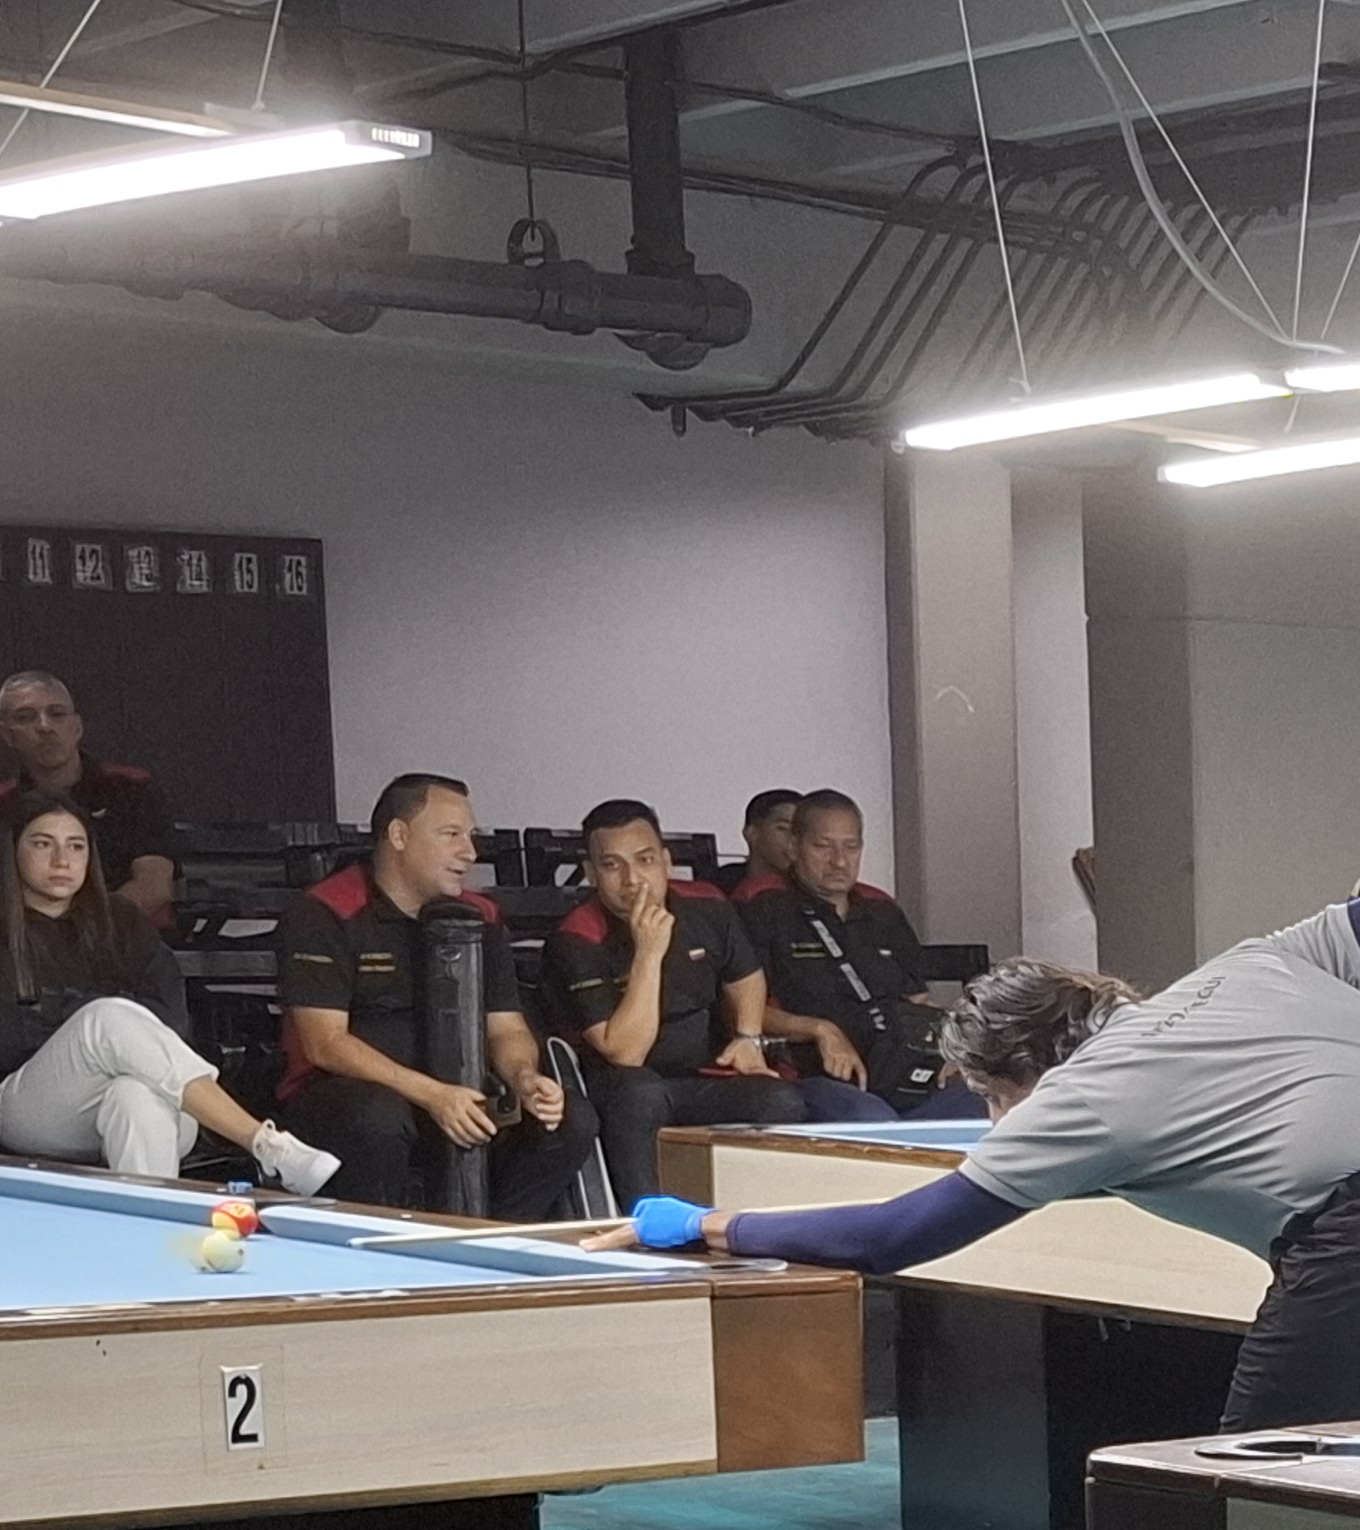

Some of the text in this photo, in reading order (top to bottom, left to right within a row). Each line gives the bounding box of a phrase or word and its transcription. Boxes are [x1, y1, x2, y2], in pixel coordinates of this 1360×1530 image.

[30, 544, 46, 579] 11
[78, 546, 102, 582] 12
[238, 555, 255, 590] 15
[287, 558, 304, 593] 16
[228, 1374, 259, 1445] 2
